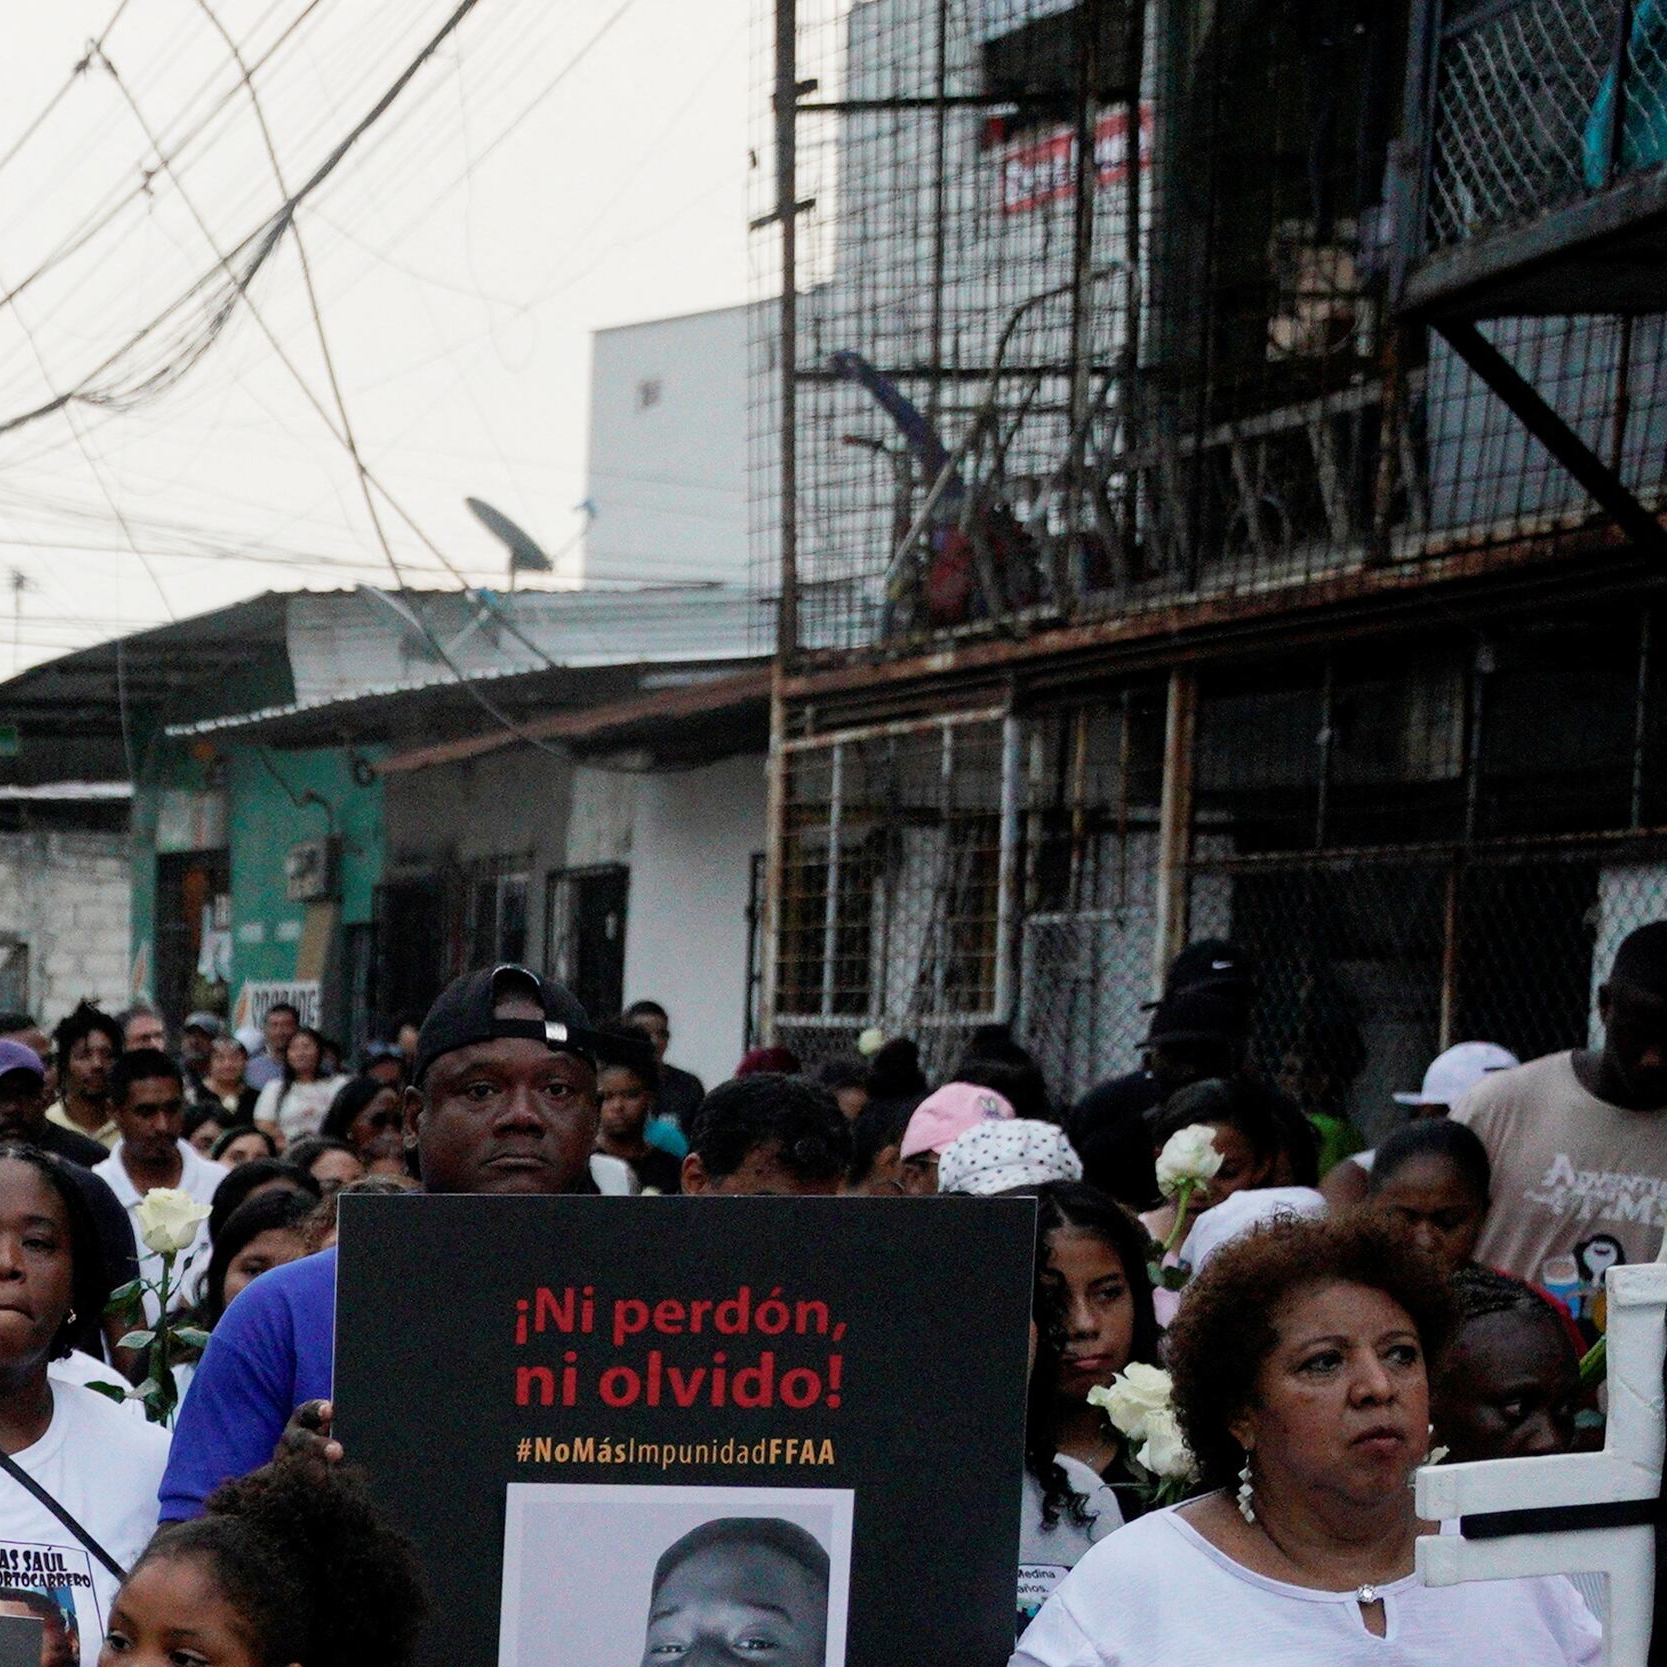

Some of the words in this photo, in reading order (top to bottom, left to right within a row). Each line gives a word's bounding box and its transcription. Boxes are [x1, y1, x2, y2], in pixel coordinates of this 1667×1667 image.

[516, 1287, 593, 1344] ¡Ni
[614, 1287, 845, 1345] perdón,
[517, 1352, 576, 1405] ni
[600, 1351, 842, 1408] olvido!
[517, 1437, 835, 1469] #NoMásImpunidadFFAA
[23, 1546, 68, 1572] SAÚL
